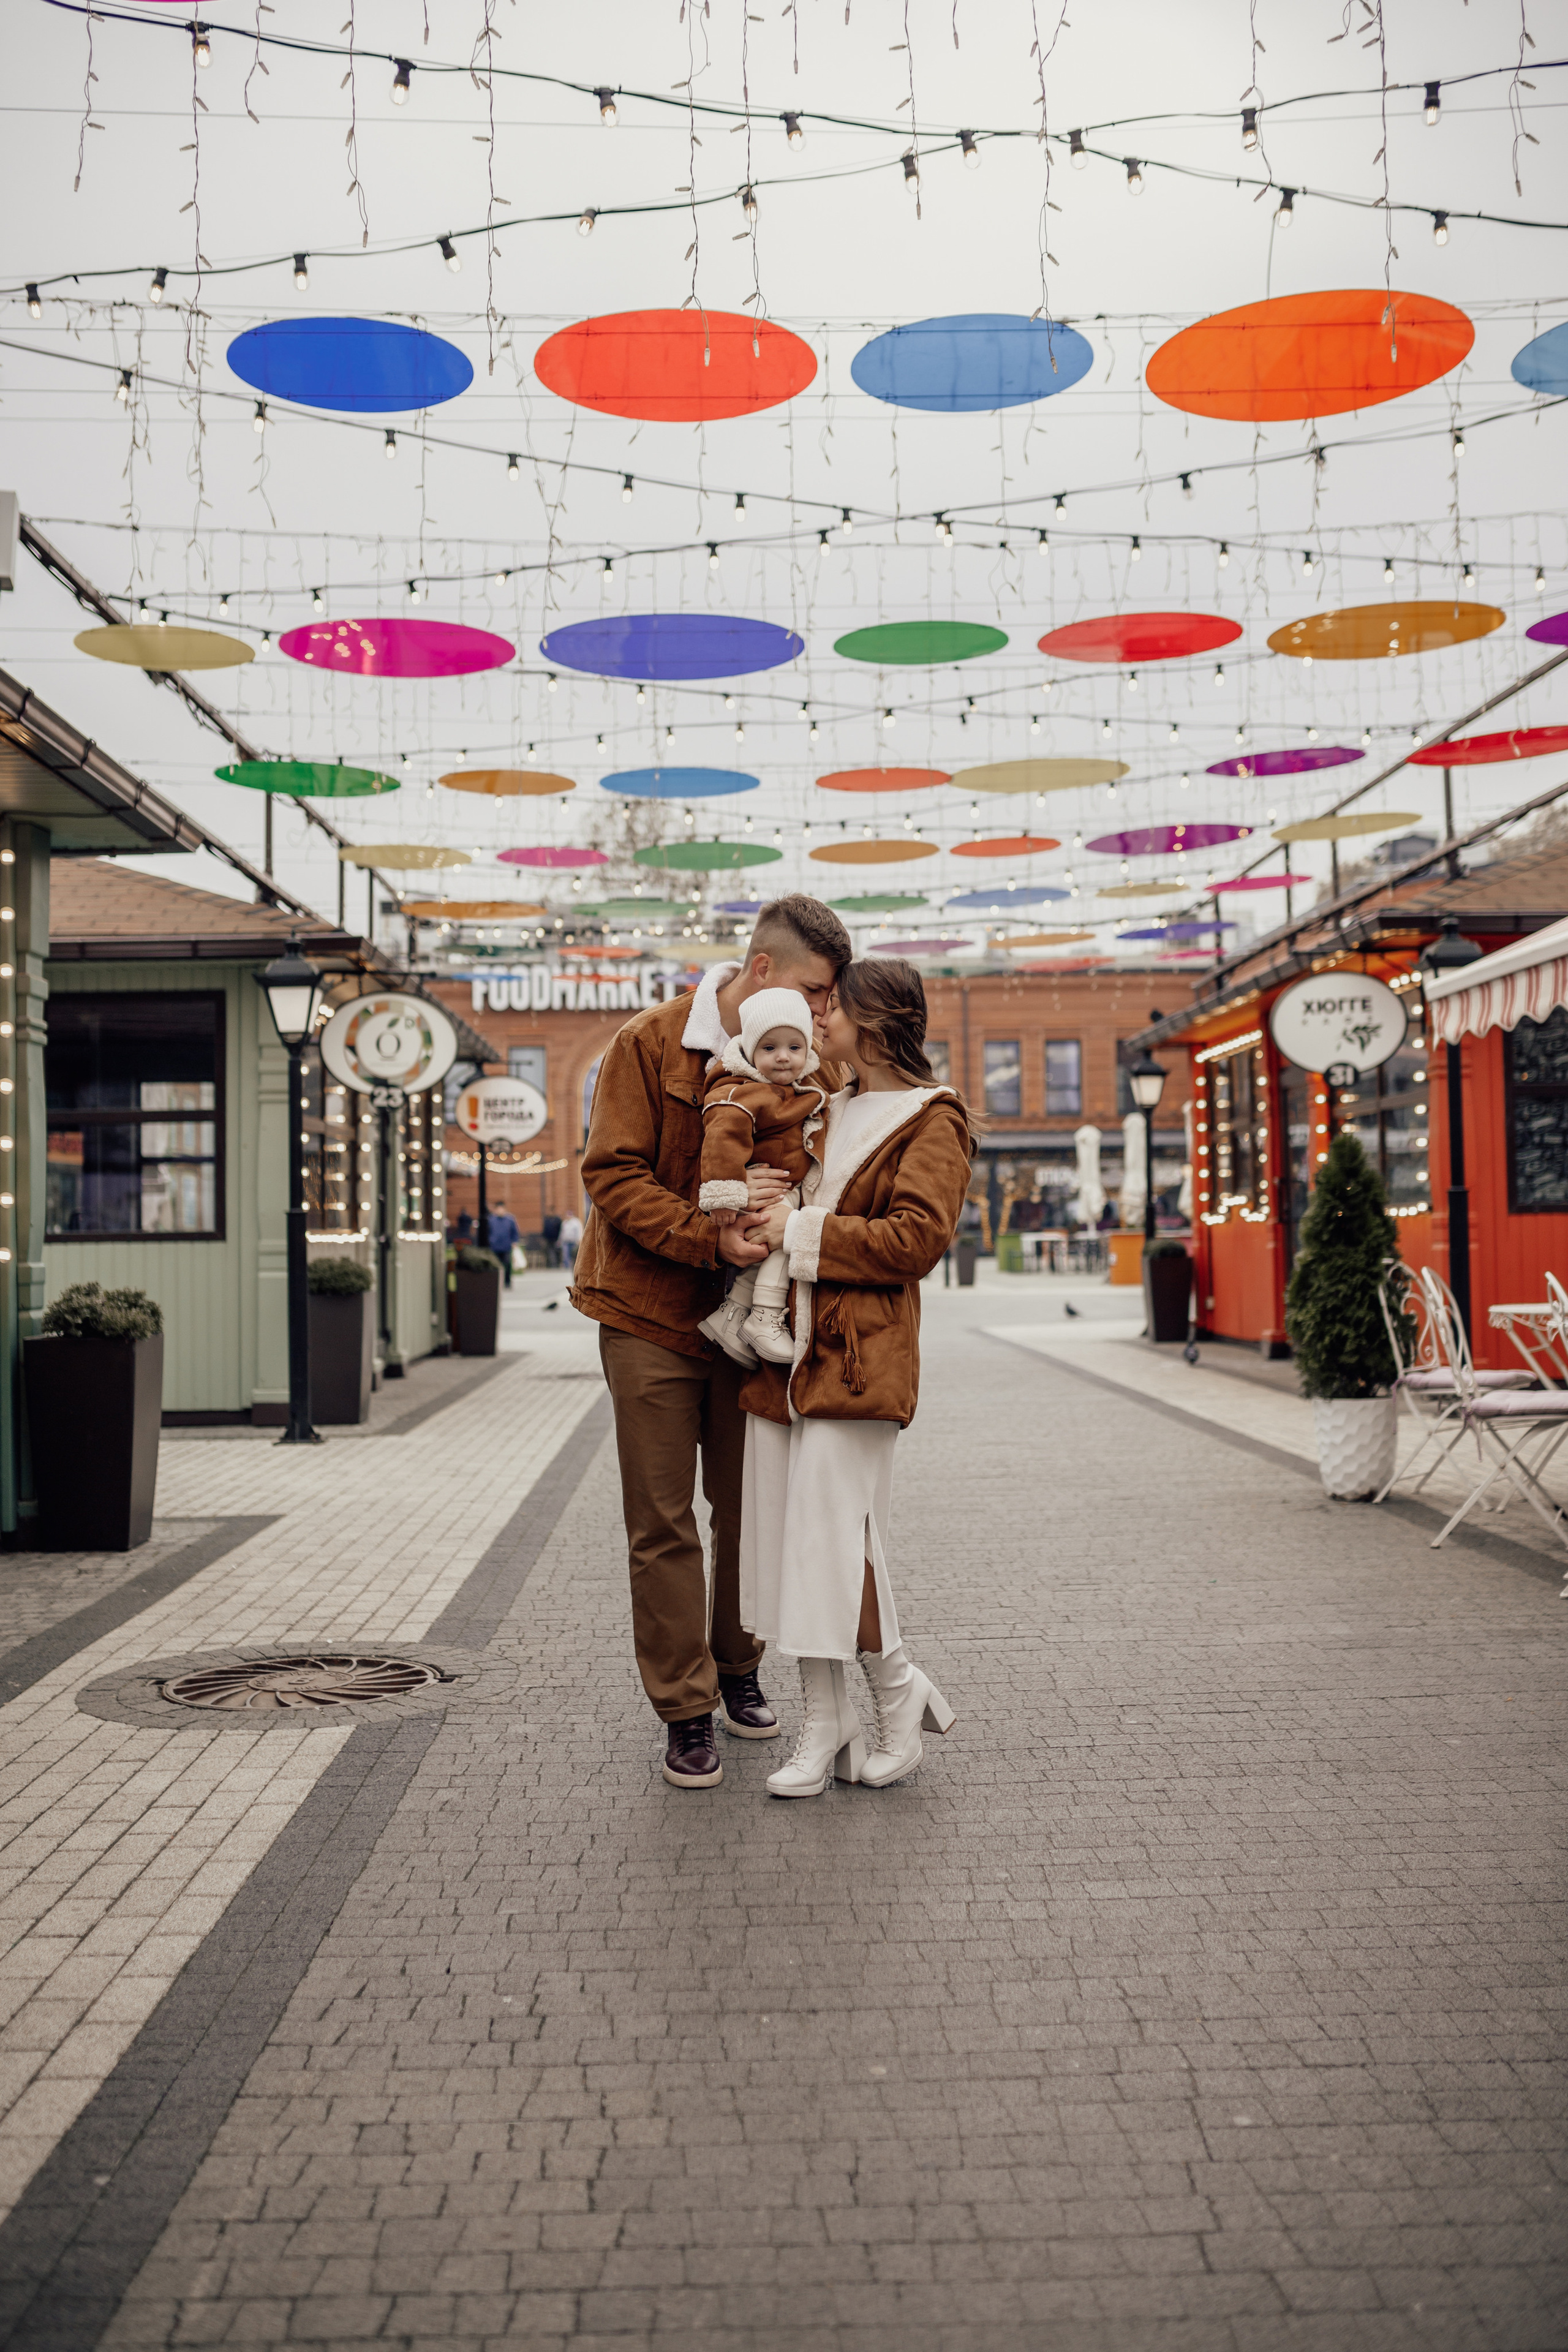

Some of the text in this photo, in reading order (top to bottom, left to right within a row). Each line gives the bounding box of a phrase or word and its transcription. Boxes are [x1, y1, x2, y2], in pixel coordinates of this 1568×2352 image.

[472, 962, 680, 1012] FOODMARKET
[1303, 995, 1372, 1015] ХЮГГЕ
[1329, 1064, 1355, 1086] 31
[372, 1086, 404, 1108] 23
